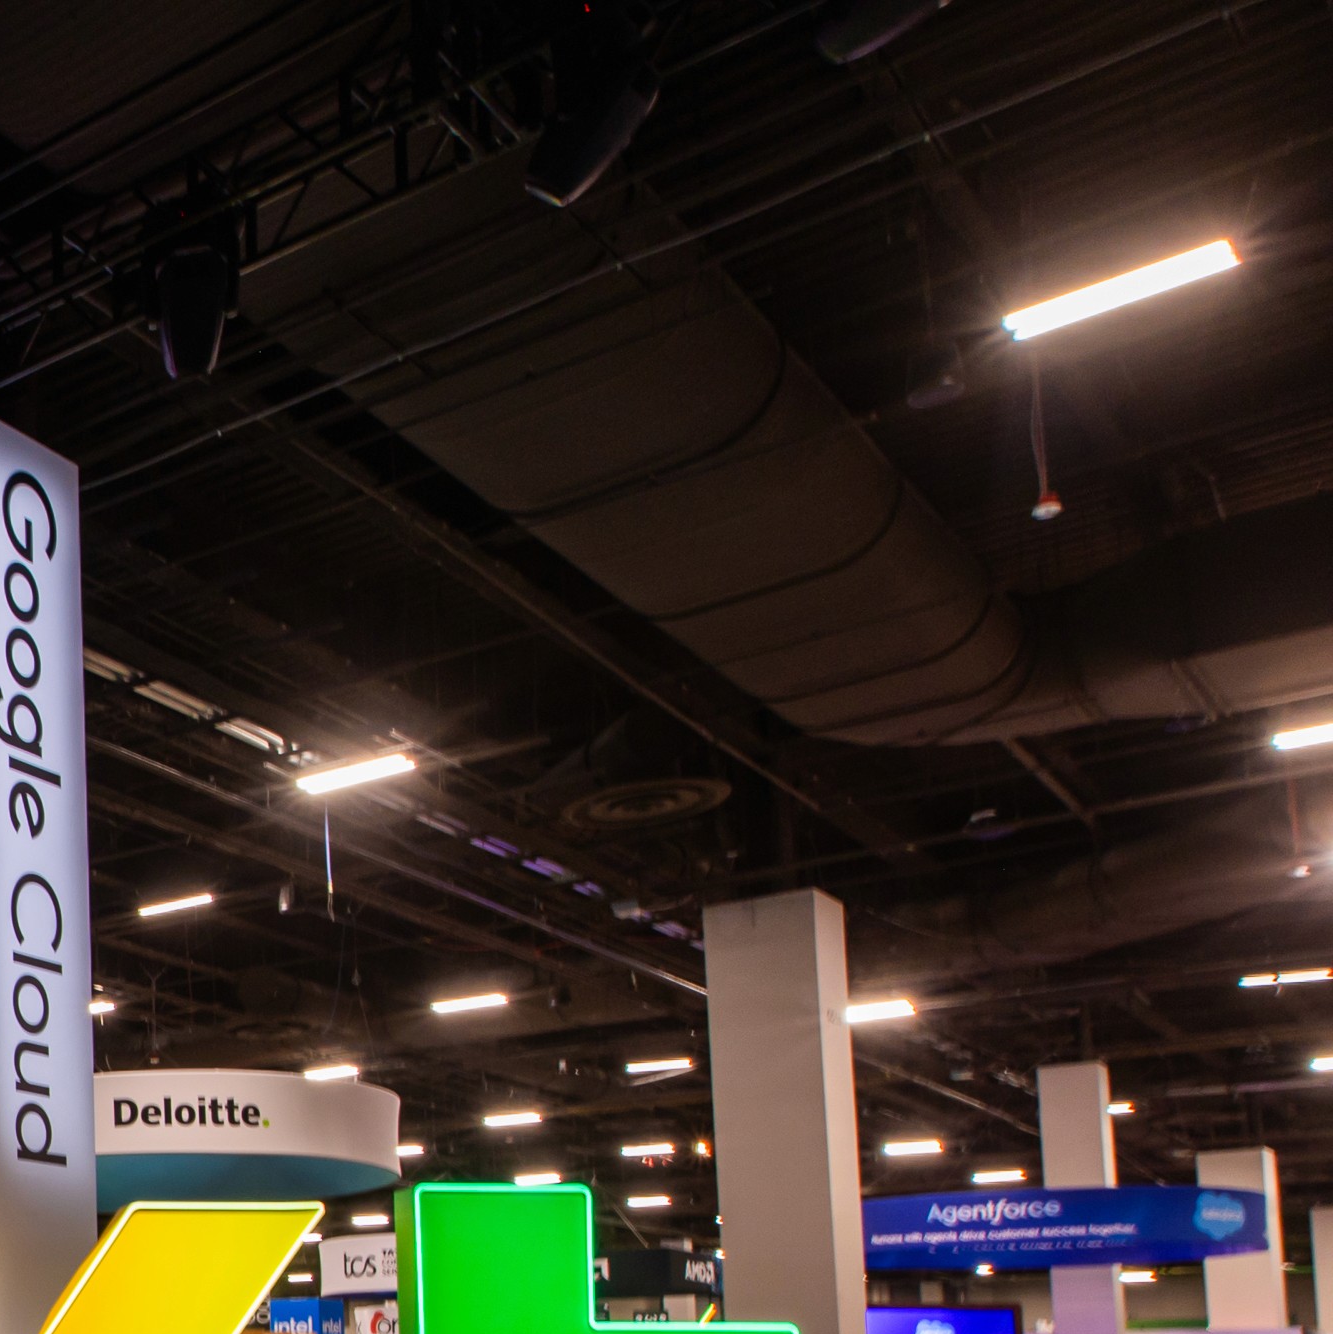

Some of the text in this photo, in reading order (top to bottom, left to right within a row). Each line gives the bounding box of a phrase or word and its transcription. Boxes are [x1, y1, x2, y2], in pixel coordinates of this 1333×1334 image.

[10, 873, 67, 1168] Cloud
[927, 1198, 1062, 1227] Agentforce
[343, 1252, 377, 1278] tcs
[685, 1259, 710, 1283] AMD
